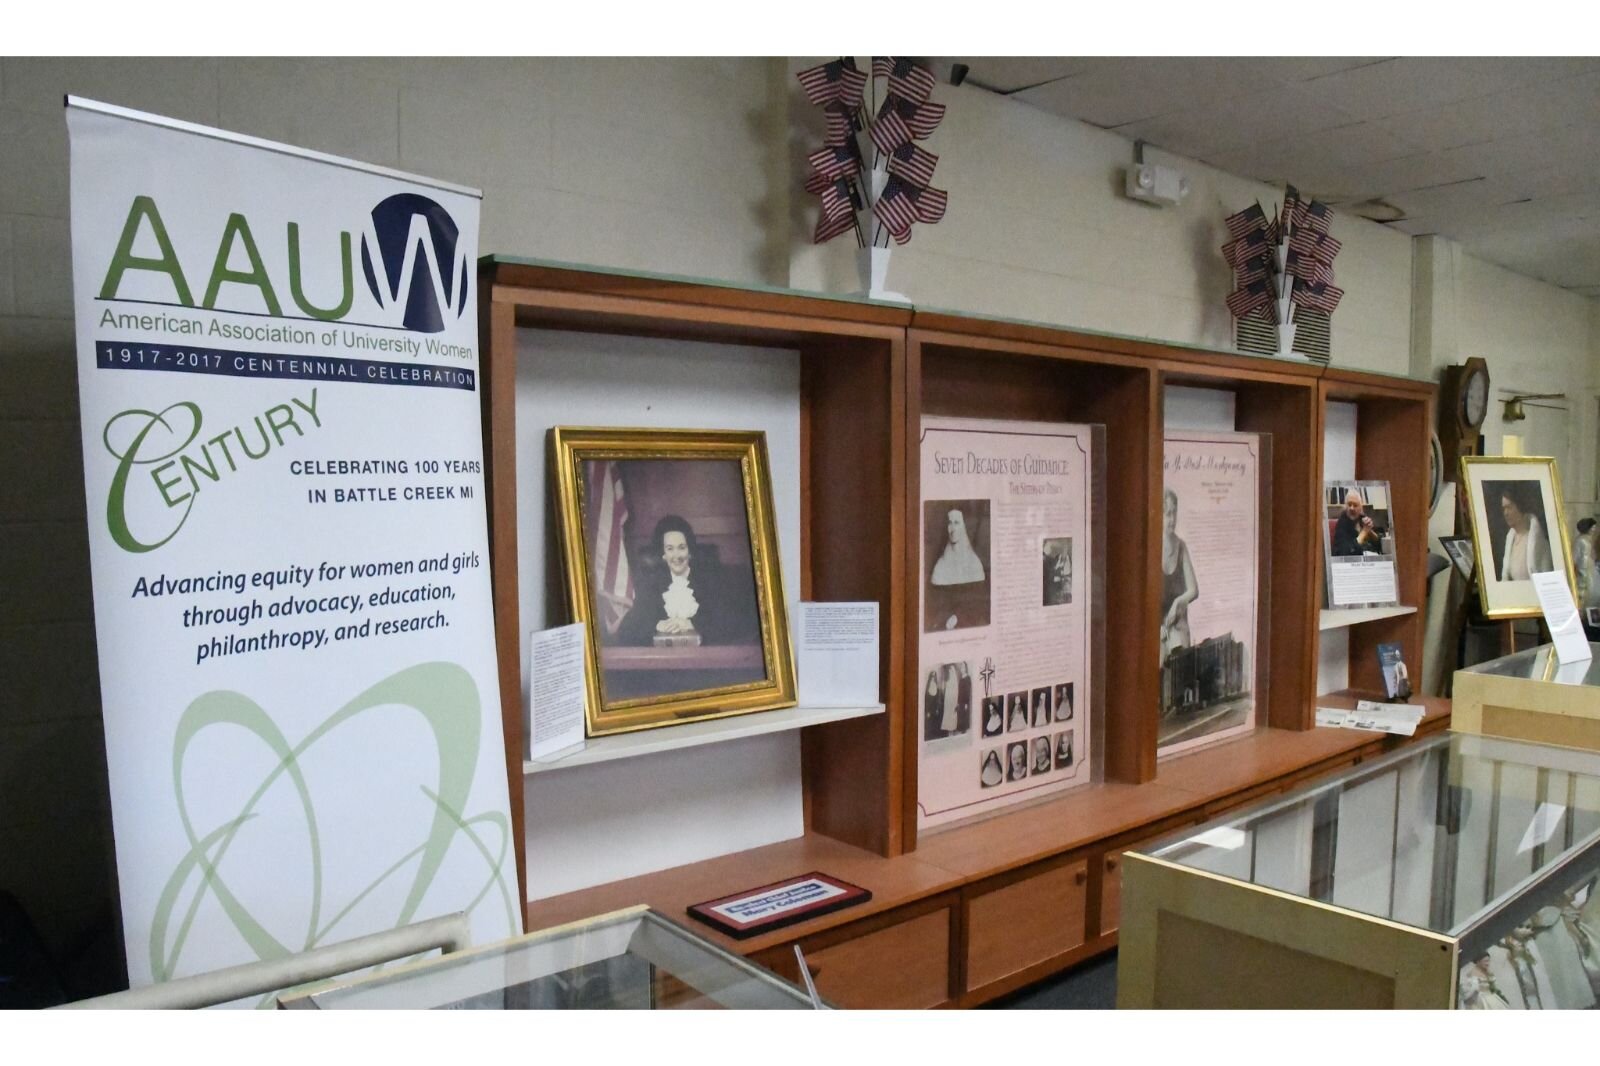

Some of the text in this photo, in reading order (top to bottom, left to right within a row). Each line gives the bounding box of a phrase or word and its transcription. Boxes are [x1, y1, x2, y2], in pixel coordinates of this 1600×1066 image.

[98, 192, 467, 332] AAUW
[100, 308, 473, 359] American Association of University Women
[106, 348, 473, 386] 1917-2017 CENTENNIAL CELEBRATION
[103, 387, 321, 553] CENTURY
[290, 461, 481, 475] CELEBRATING 100 YEARS
[967, 451, 1008, 475] DECADES
[308, 486, 473, 503] IN BATTLE CREEK MI
[131, 550, 480, 598] Advancing equity for women and girls
[182, 583, 456, 627] through advocacy, education,
[196, 610, 450, 665] philanthropy, and research.
